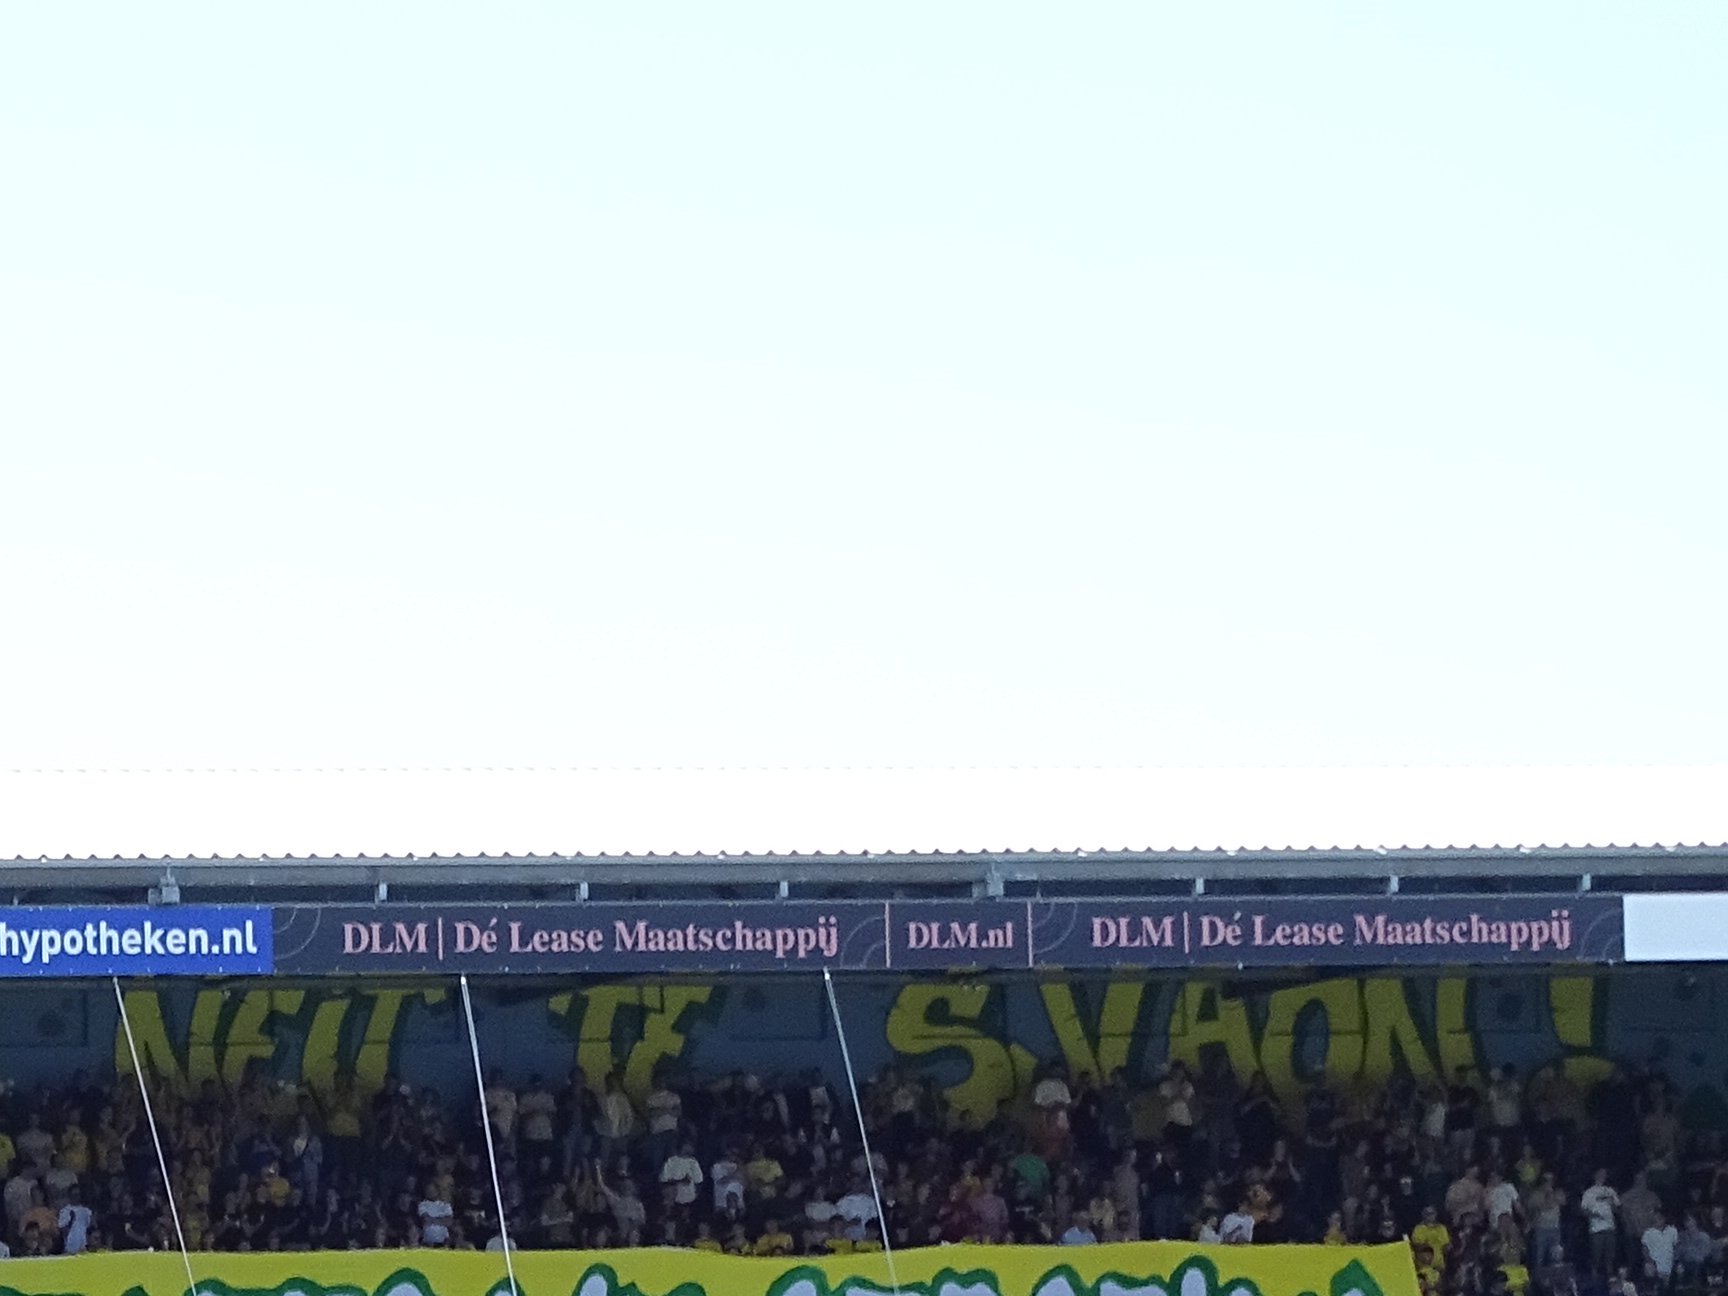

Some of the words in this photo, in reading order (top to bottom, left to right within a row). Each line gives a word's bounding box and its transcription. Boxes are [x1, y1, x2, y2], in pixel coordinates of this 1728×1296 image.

[344, 921, 428, 954] DLM
[454, 916, 498, 954] Dé
[509, 920, 604, 953] Lease
[907, 920, 1015, 949] DLM.nl
[1091, 916, 1175, 948] DLM
[1201, 911, 1243, 947] Dé
[1252, 915, 1344, 947] Lease
